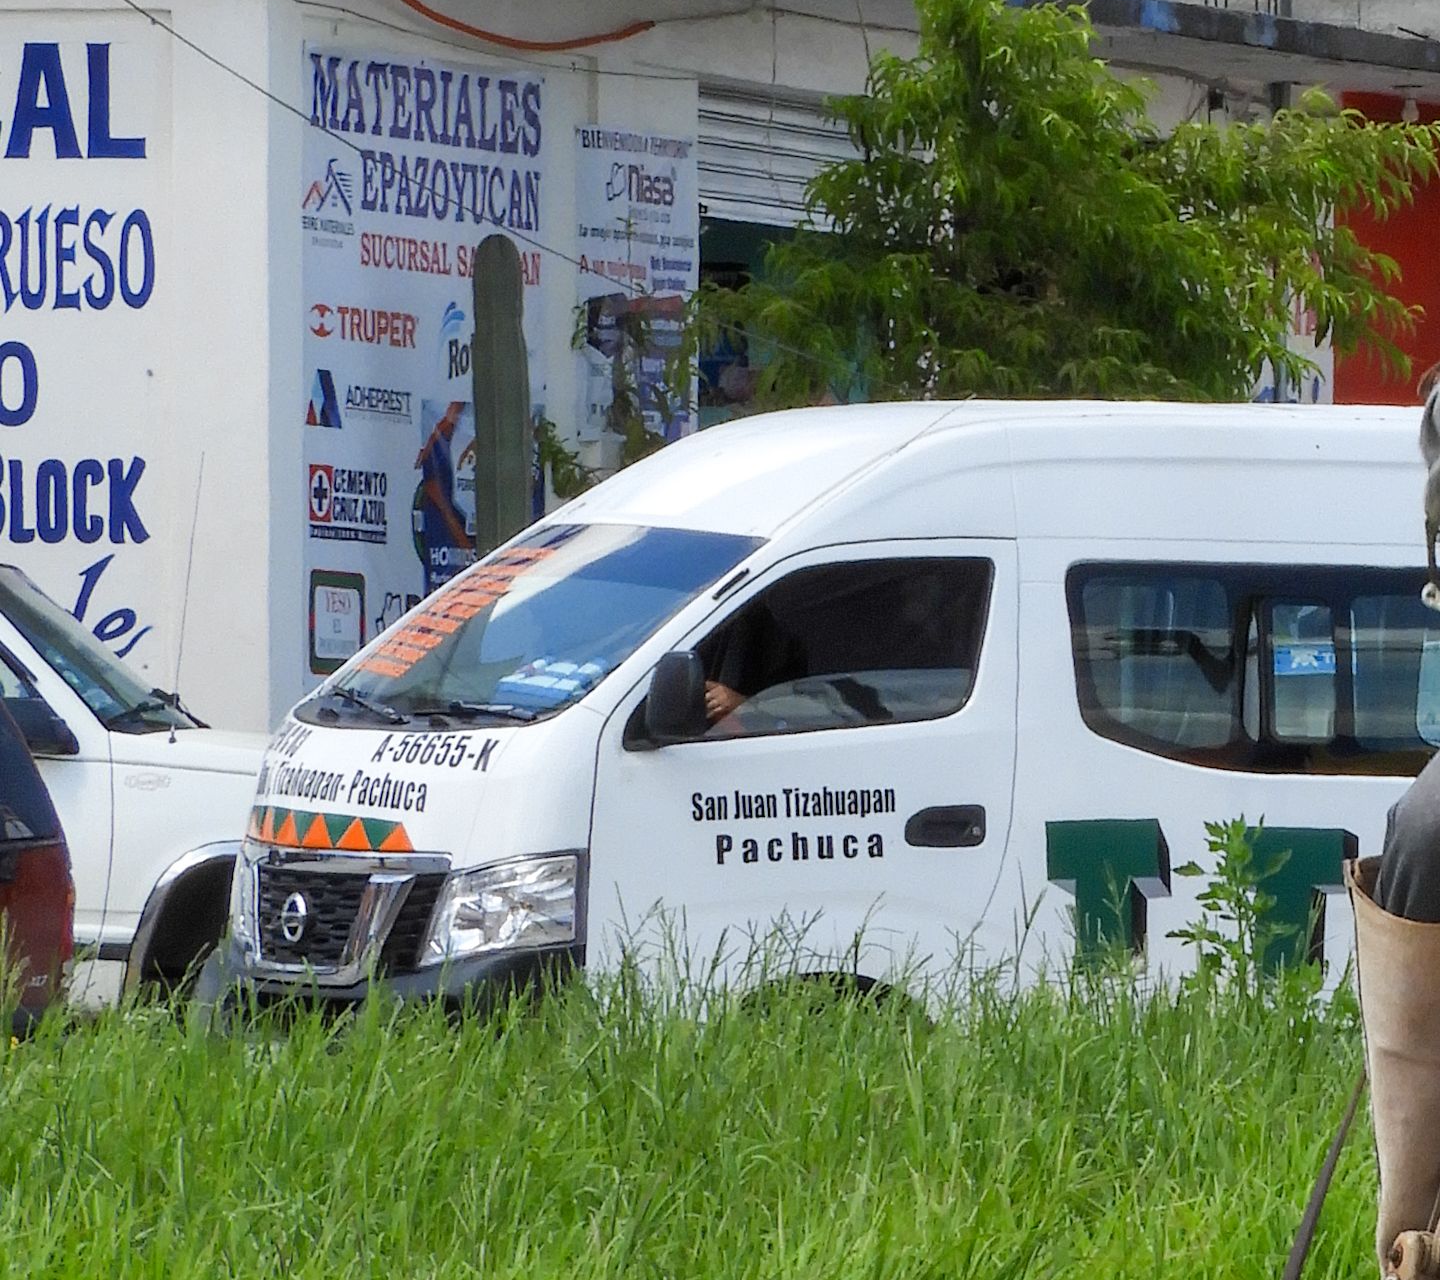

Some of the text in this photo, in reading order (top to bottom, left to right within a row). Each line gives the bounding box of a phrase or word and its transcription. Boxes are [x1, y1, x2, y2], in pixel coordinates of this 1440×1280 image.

[310, 53, 542, 158] MATERIALES
[361, 149, 542, 232] EPAZOYUCAN
[361, 232, 451, 276] SUCURSAL
[337, 306, 416, 349] TRUPER
[333, 468, 387, 497] CEMENTO
[333, 496, 387, 526] CRUZ AZUL
[371, 734, 500, 772] A-56655-K
[347, 770, 428, 813] Pachuca
[691, 786, 895, 821] San Juan Tizahuapan
[715, 831, 884, 865] Pachuca
